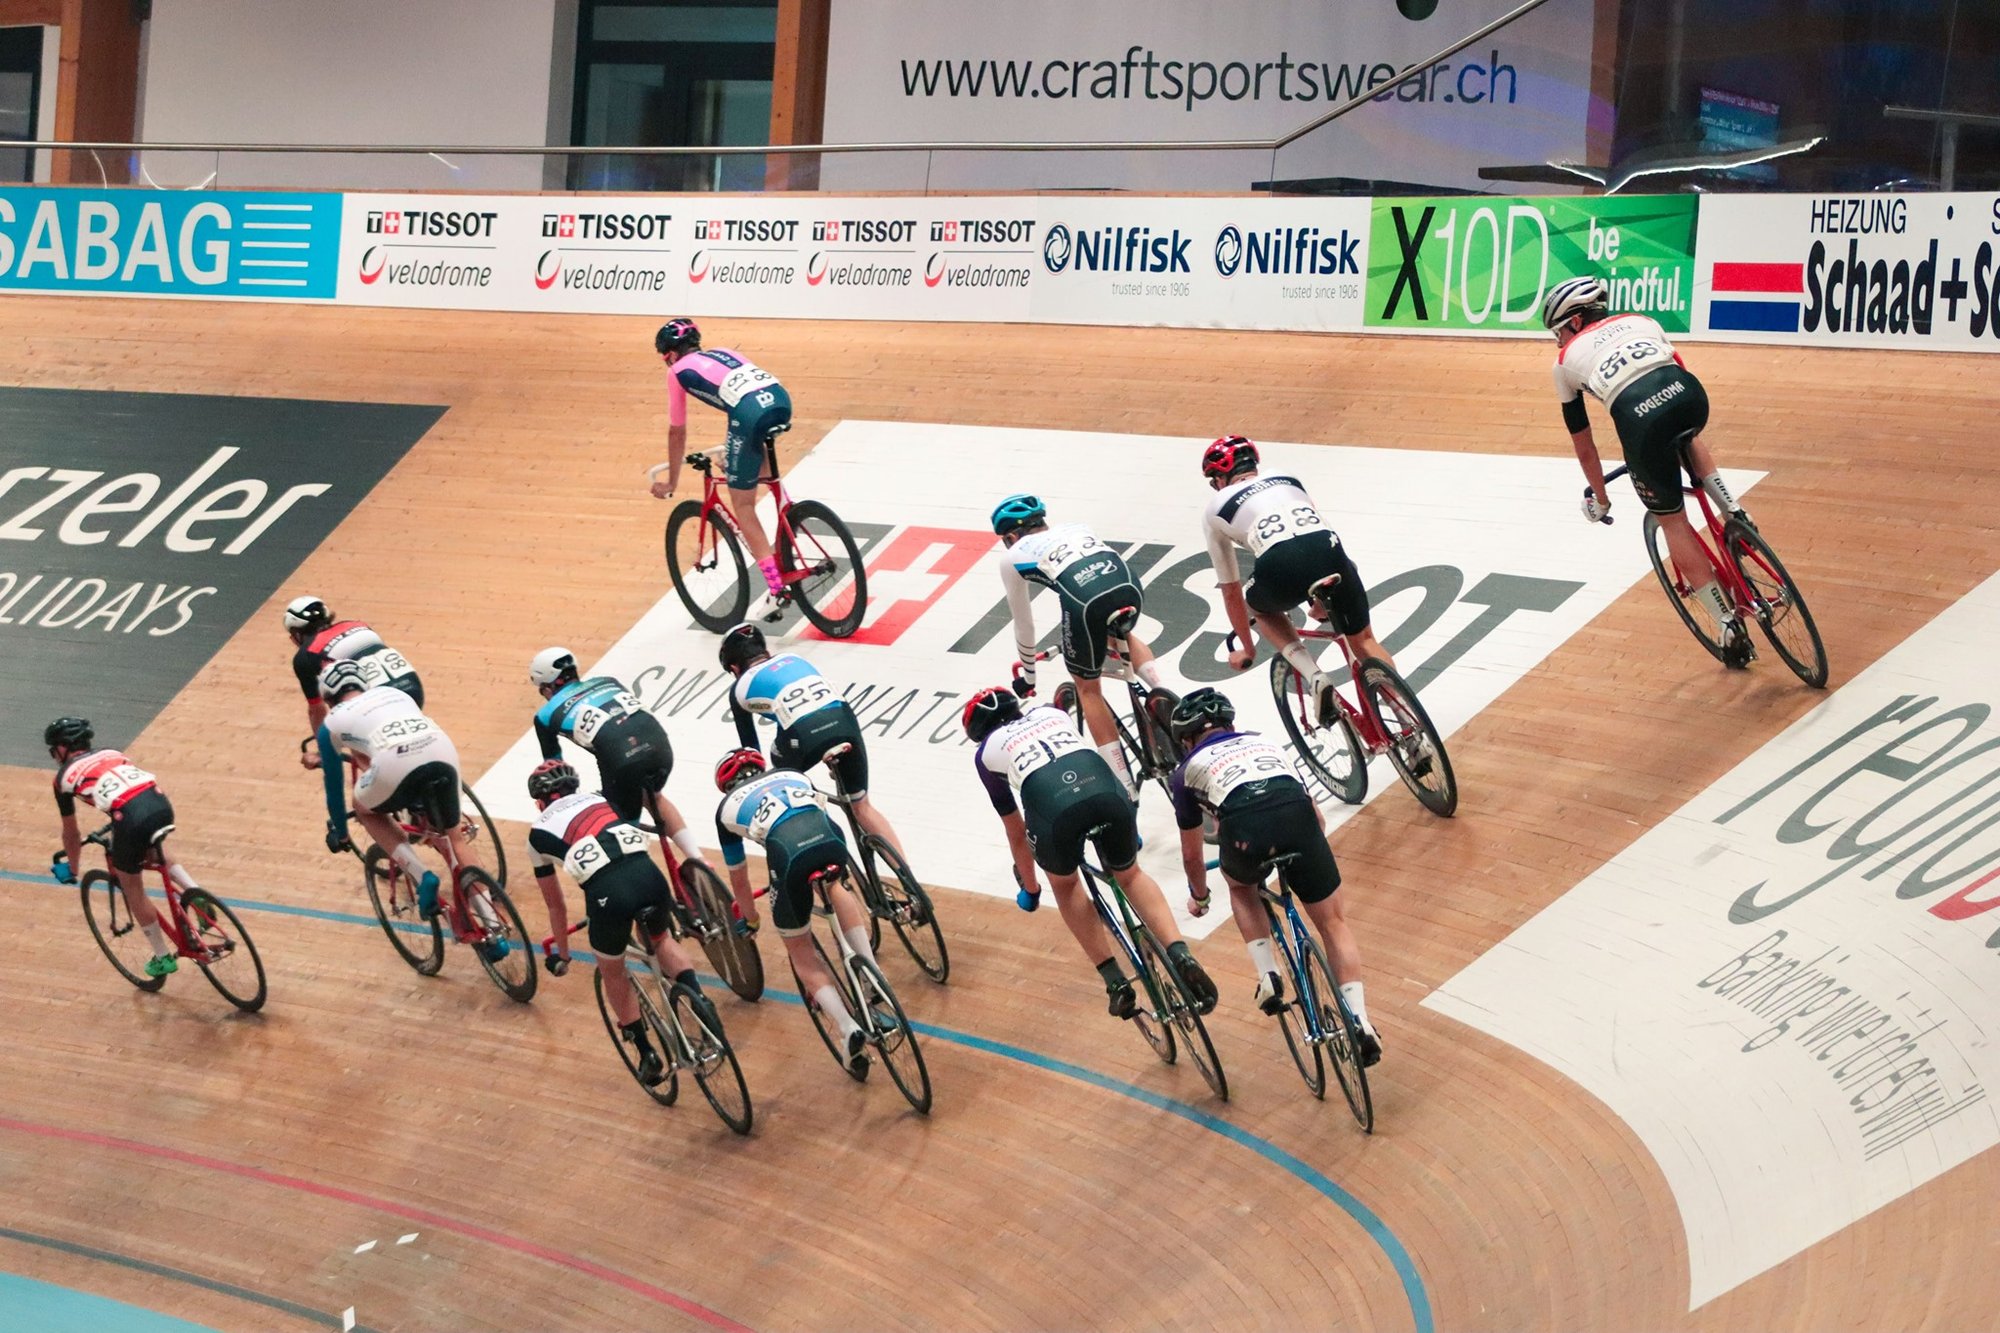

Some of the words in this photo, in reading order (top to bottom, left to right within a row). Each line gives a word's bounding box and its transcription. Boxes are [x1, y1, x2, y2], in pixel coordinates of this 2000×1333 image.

[901, 46, 1517, 112] www.craftsportswear.ch
[1811, 198, 1907, 234] HEIZUNG
[1074, 227, 1193, 273] Nilfisk
[1245, 228, 1361, 274] Nilfisk
[1587, 217, 1620, 261] be
[388, 260, 492, 287] velodrome
[563, 263, 666, 291] velodrome
[710, 261, 795, 284] velodrome
[829, 262, 912, 286] velodrome
[947, 263, 1031, 287] velodrome
[1112, 282, 1142, 296] trusted
[1145, 283, 1167, 297] since
[1170, 283, 1190, 297] 1906
[1282, 284, 1312, 299] trusted
[1315, 285, 1336, 299] since
[1339, 285, 1359, 300] 1906
[1626, 341, 1659, 361] 85
[1599, 350, 1629, 381] 85
[727, 372, 750, 392] 81
[1633, 380, 1686, 418] SOGECOMA
[1257, 513, 1286, 540] 83
[1291, 506, 1321, 527] 83
[384, 652, 407, 671] 80
[632, 665, 776, 726] SWI
[782, 688, 810, 714] 91
[807, 681, 831, 701] 91
[382, 721, 407, 739] 87
[404, 718, 428, 733] 87
[579, 709, 601, 733] 95
[1047, 731, 1079, 750] 73
[1013, 743, 1042, 772] 73
[1253, 755, 1286, 772] 90
[98, 777, 120, 799] 92
[1216, 764, 1247, 788] 90
[754, 796, 776, 823] 86
[573, 842, 601, 870] 82
[1696, 929, 1852, 1054] Banking
[1795, 991, 1911, 1062] wie
[1827, 1009, 1949, 1092] ich
[1849, 1058, 1937, 1114] es
[1859, 1084, 1987, 1162] will
